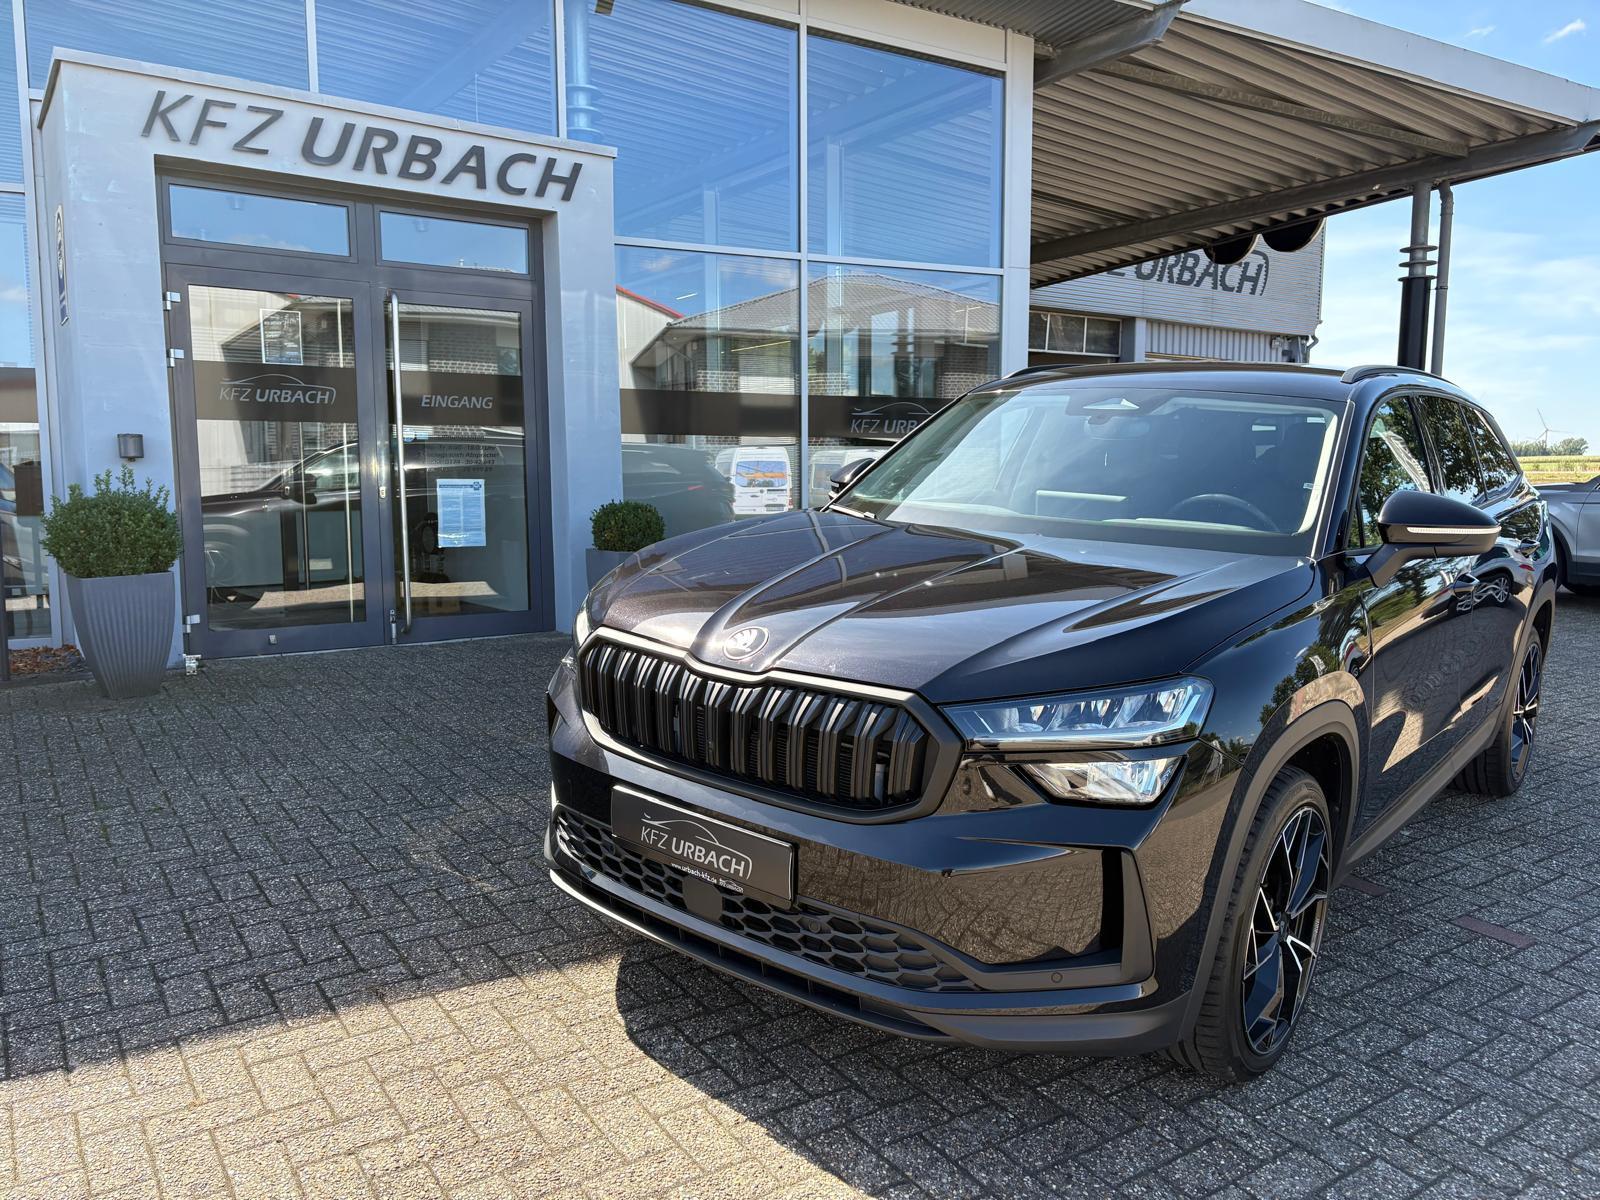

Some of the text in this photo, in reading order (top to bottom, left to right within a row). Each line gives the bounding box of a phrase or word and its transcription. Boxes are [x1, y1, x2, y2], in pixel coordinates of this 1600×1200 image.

[141, 90, 583, 202] KFZ URBACH
[1134, 252, 1264, 296] URBACH
[219, 387, 330, 404] KFZ URBACH
[421, 394, 494, 409] EINGANG
[850, 419, 881, 434] KFZ
[640, 826, 745, 877] KFZ URBACH
